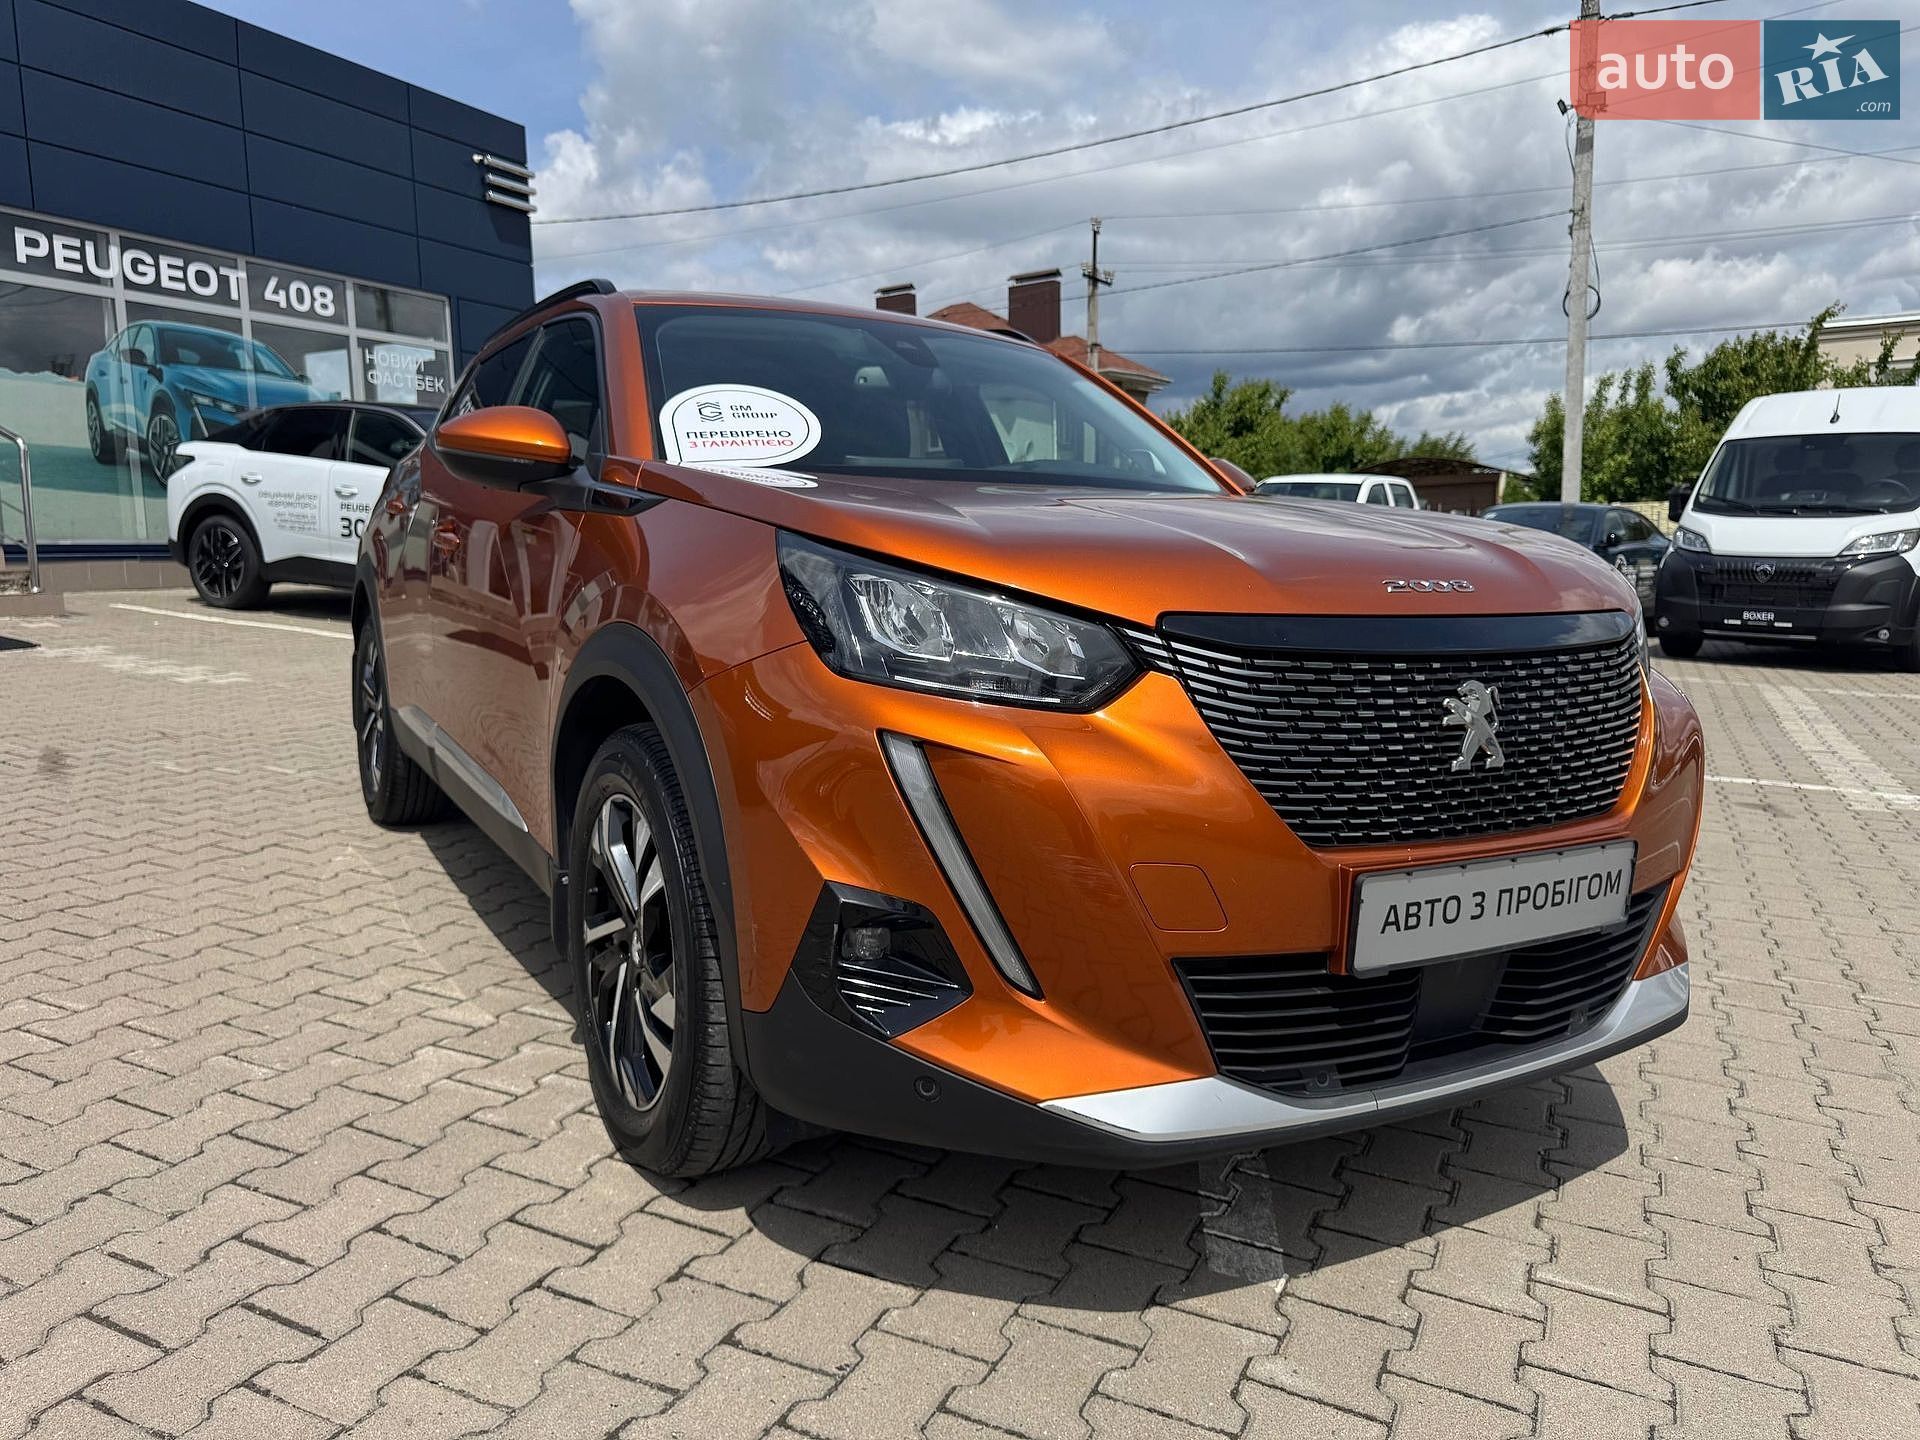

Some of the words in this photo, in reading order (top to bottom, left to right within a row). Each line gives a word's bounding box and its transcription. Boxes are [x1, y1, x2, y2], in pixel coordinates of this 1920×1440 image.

[14, 226, 247, 302] PEUGEOT
[264, 275, 335, 318] 408
[367, 369, 445, 393] ФАСТБЕК
[730, 404, 752, 412] GM
[686, 430, 791, 440] ПЕРЕВІРЕНО
[702, 439, 794, 448] ГАРАНТІЄЮ
[341, 502, 371, 514] PEUGE
[1382, 579, 1475, 593] 2008
[1743, 611, 1774, 621] BOXER
[1380, 895, 1462, 934] АВТО
[1496, 869, 1623, 917] ПРОБІГОМ
